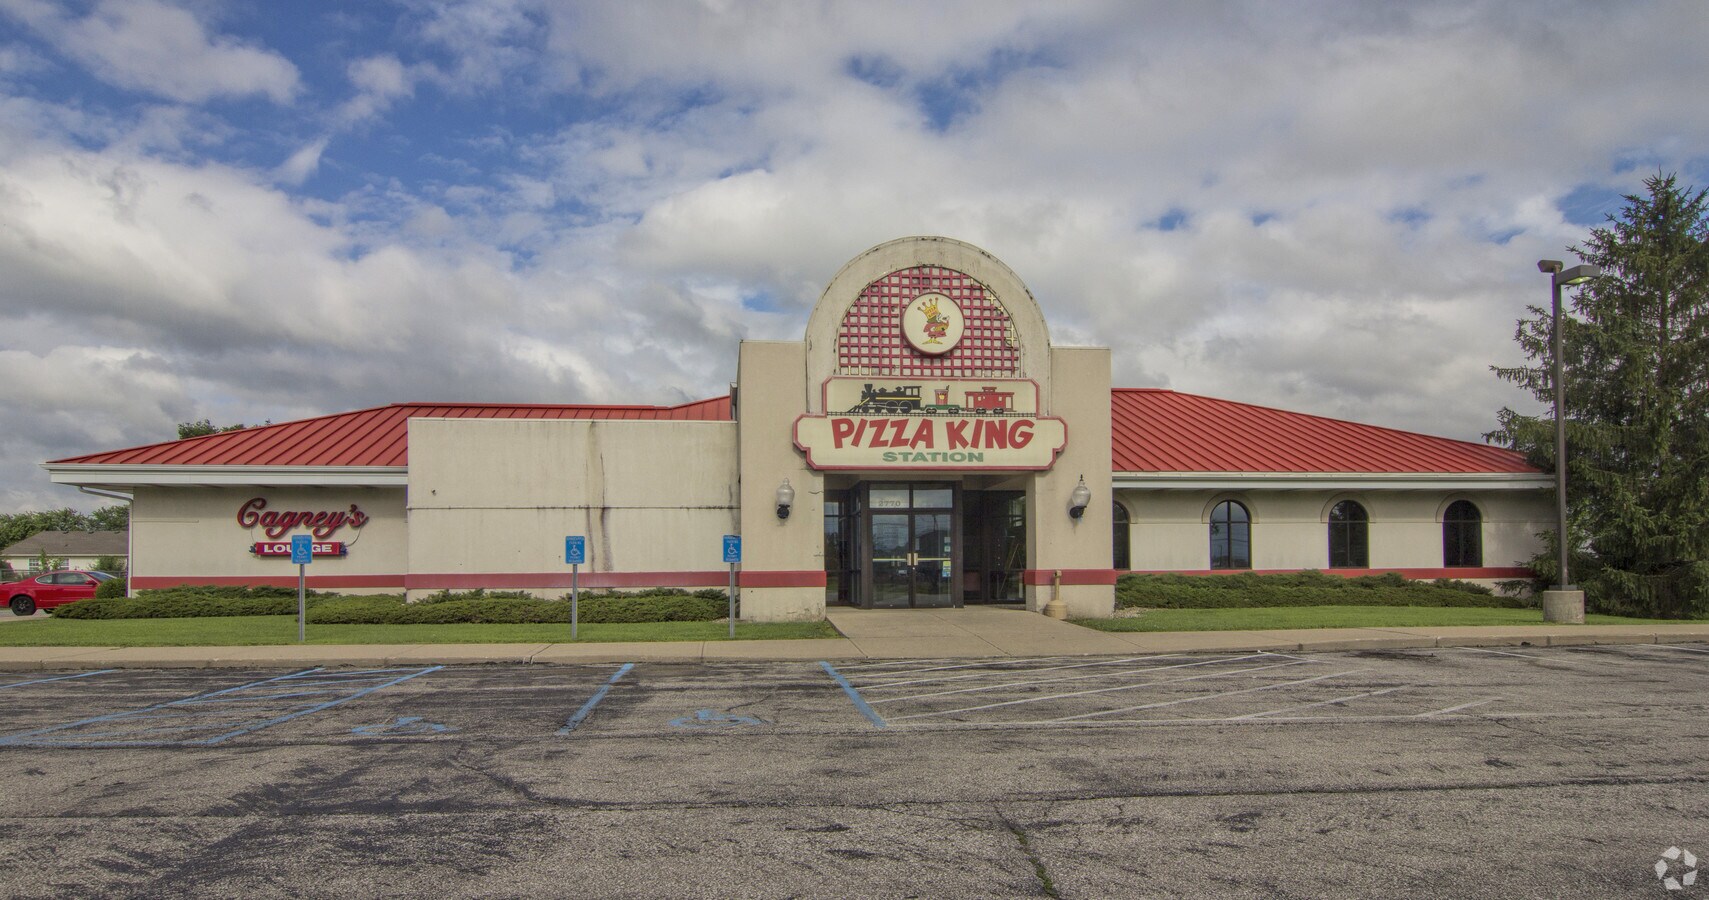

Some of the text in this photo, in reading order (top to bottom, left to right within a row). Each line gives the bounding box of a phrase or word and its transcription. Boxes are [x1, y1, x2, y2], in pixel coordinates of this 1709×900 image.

[831, 418, 1035, 449] PIZZA KING
[882, 451, 984, 463] STATION
[237, 497, 369, 539] Cagney's
[263, 544, 333, 552] LOUGE
